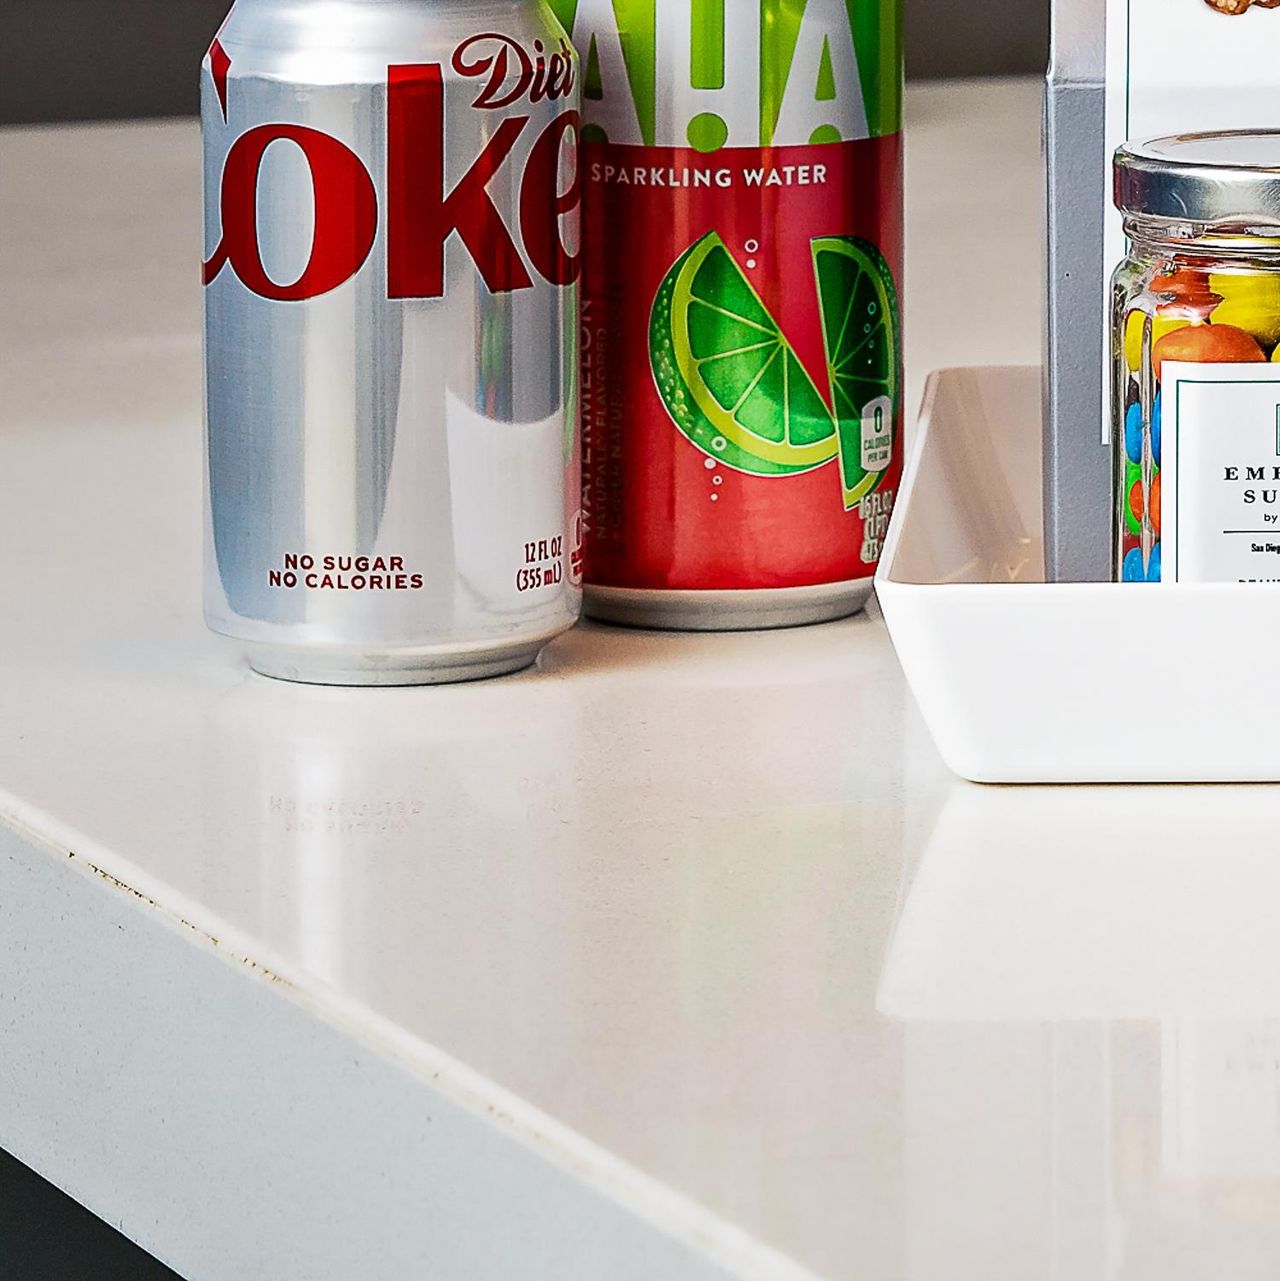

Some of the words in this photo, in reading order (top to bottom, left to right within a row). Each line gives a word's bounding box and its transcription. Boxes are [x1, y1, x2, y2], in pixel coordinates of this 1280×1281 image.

[452, 32, 575, 109] Diet
[202, 38, 580, 302] oke
[591, 164, 732, 188] SPARKLING
[743, 164, 827, 187] WATER
[1264, 513, 1278, 524] by
[524, 542, 536, 563] 12
[538, 540, 549, 561] FL
[551, 535, 562, 558] OZ
[285, 554, 314, 570] NO
[323, 556, 404, 572] SUGAR
[269, 571, 298, 588] NO
[305, 573, 423, 590] CALORIES
[516, 567, 542, 591] (355
